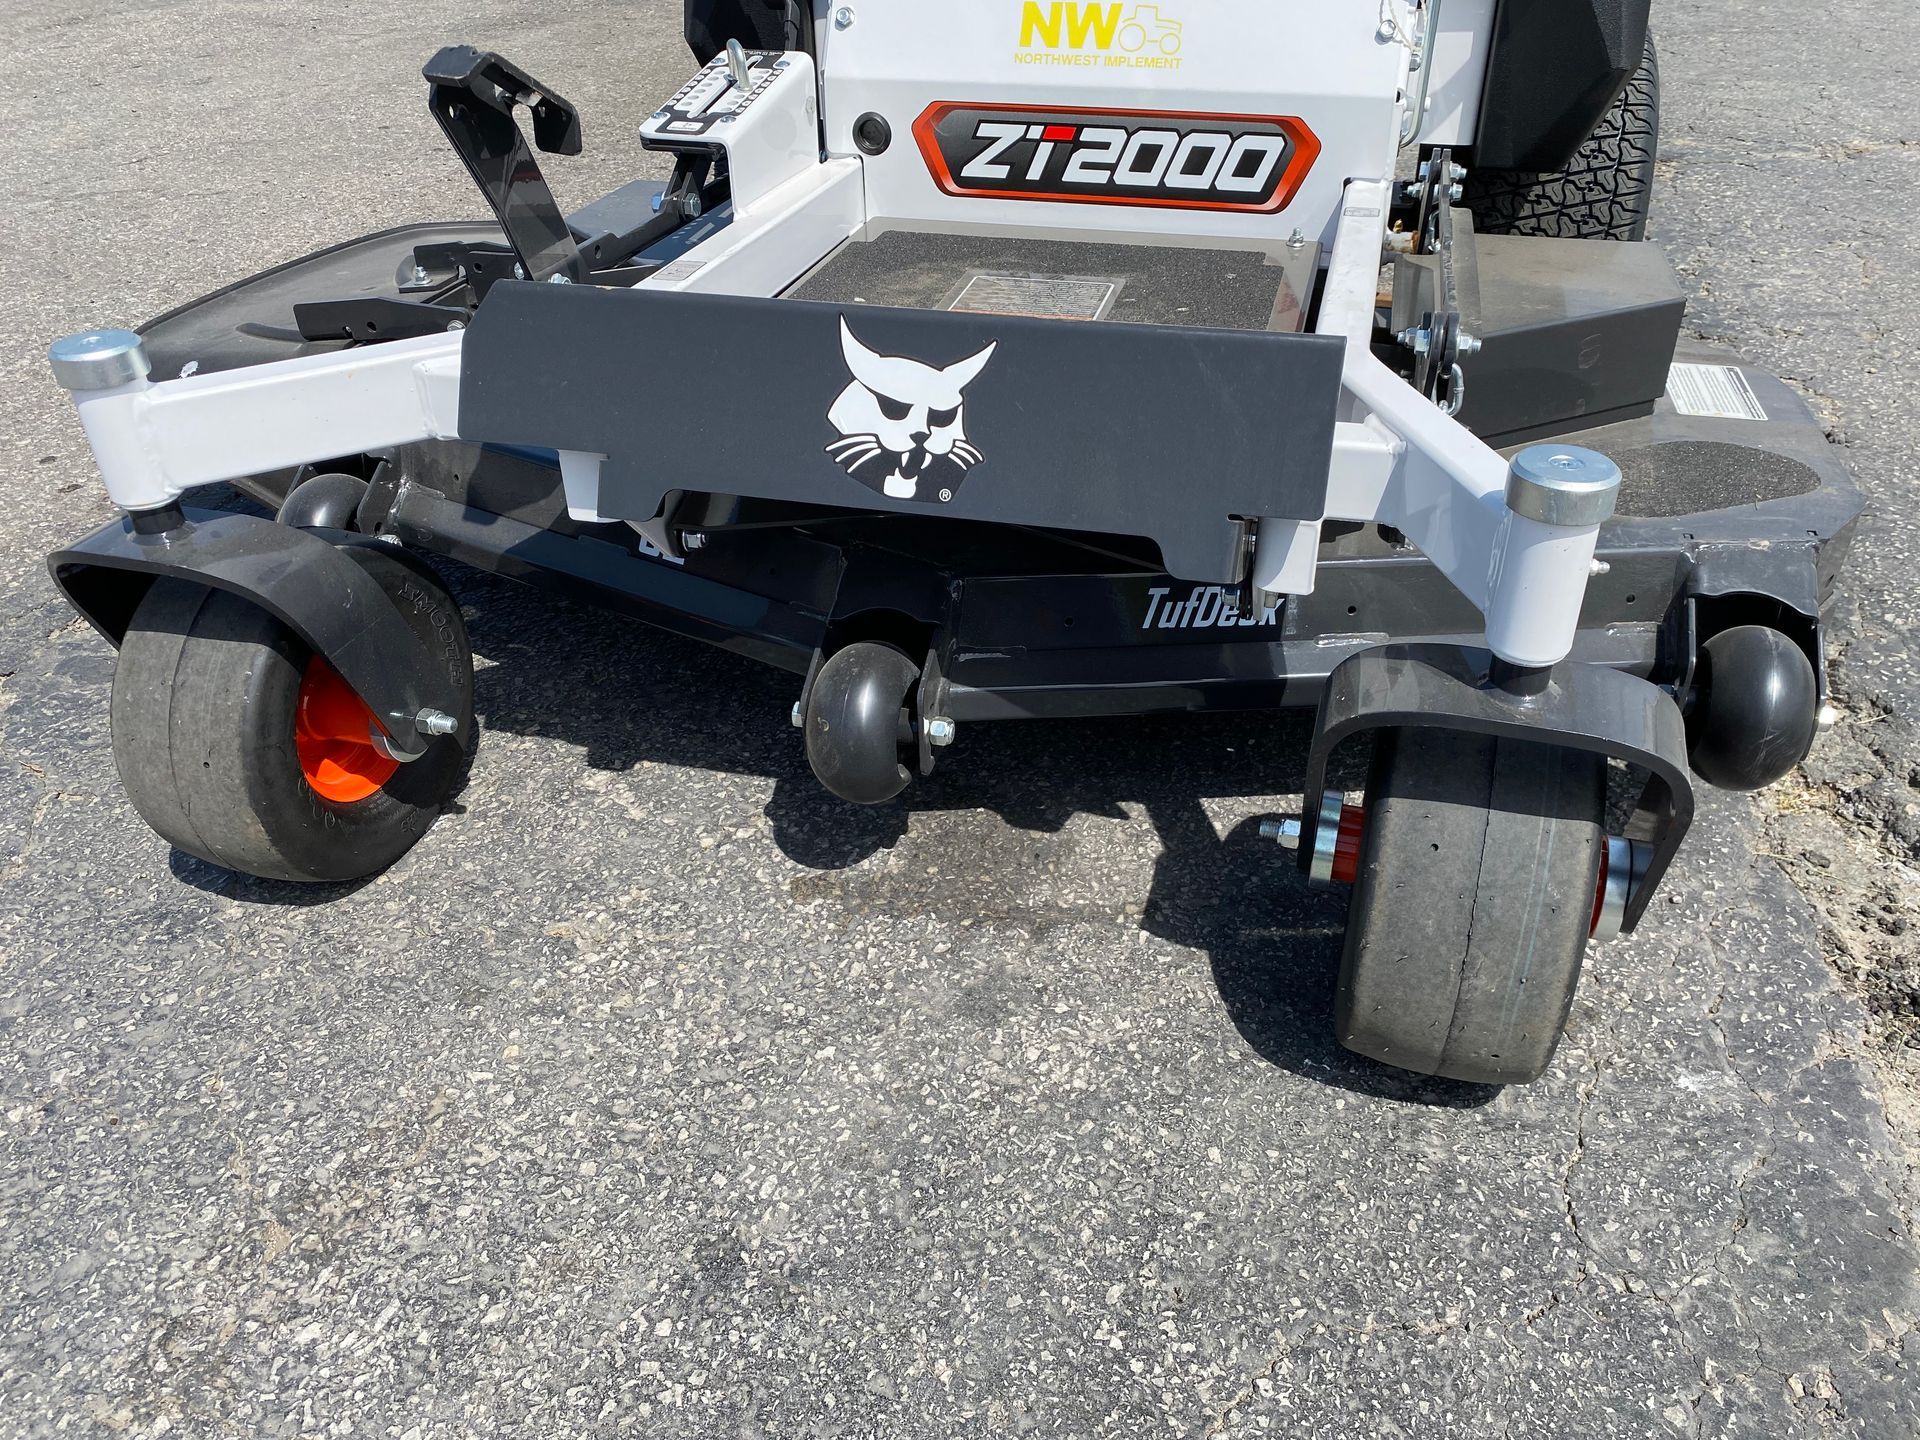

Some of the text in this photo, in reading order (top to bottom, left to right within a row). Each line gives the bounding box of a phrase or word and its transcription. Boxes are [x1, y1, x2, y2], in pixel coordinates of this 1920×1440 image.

[1019, 1, 1123, 49] NW
[1014, 53, 1182, 69] NORTHWEST IMPLEMENT
[960, 122, 1285, 193] ZT2000
